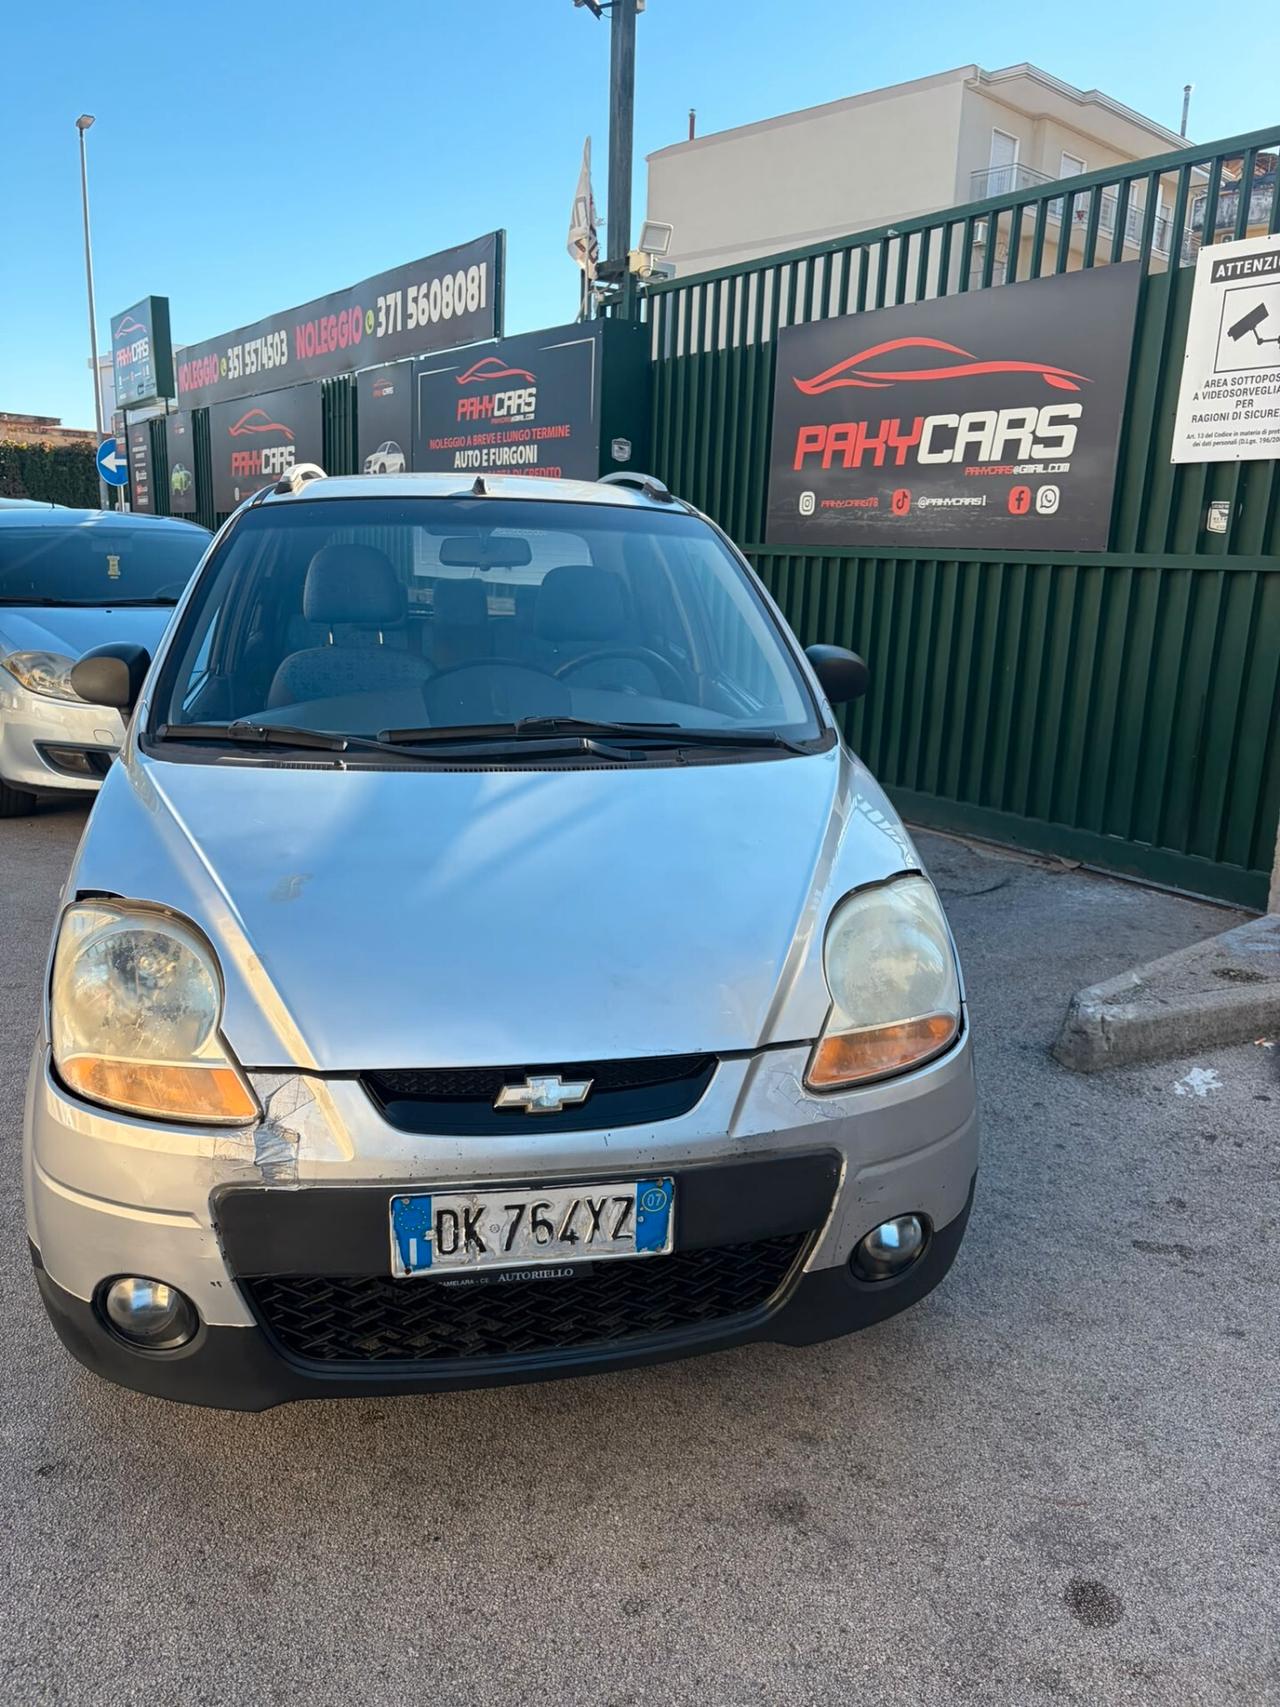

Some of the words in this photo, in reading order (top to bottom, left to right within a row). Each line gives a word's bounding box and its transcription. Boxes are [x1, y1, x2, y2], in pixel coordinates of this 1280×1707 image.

[1215, 256, 1280, 278] ATTENZI
[179, 353, 219, 392] NOLEGGIO
[227, 347, 243, 380] 351
[245, 330, 288, 374] 5574503
[296, 305, 363, 360] NOLEGGIO
[376, 290, 402, 337] 371
[407, 262, 487, 330] 5608081
[1204, 378, 1228, 389] AREA
[457, 387, 537, 422] PAKYCARS
[1193, 392, 1199, 401] A
[1235, 399, 1254, 409] PER
[1191, 412, 1230, 424] RAGIONI
[1232, 411, 1241, 421] DI
[429, 436, 466, 451] NOLEGGIO
[466, 435, 472, 446] A
[473, 432, 496, 446] BREVE
[497, 431, 502, 443] E
[504, 428, 531, 442] LUNGO
[532, 424, 571, 440] TERMINE
[793, 403, 1083, 471] PAKYCARS
[1212, 439, 1237, 447] personali
[454, 449, 481, 468] AUTO
[482, 449, 488, 467] E
[490, 444, 538, 466] FURGONI
[647, 1193, 663, 1207] 07
[436, 1205, 488, 1256] DK
[498, 1267, 574, 1283] AUTORIELLO
